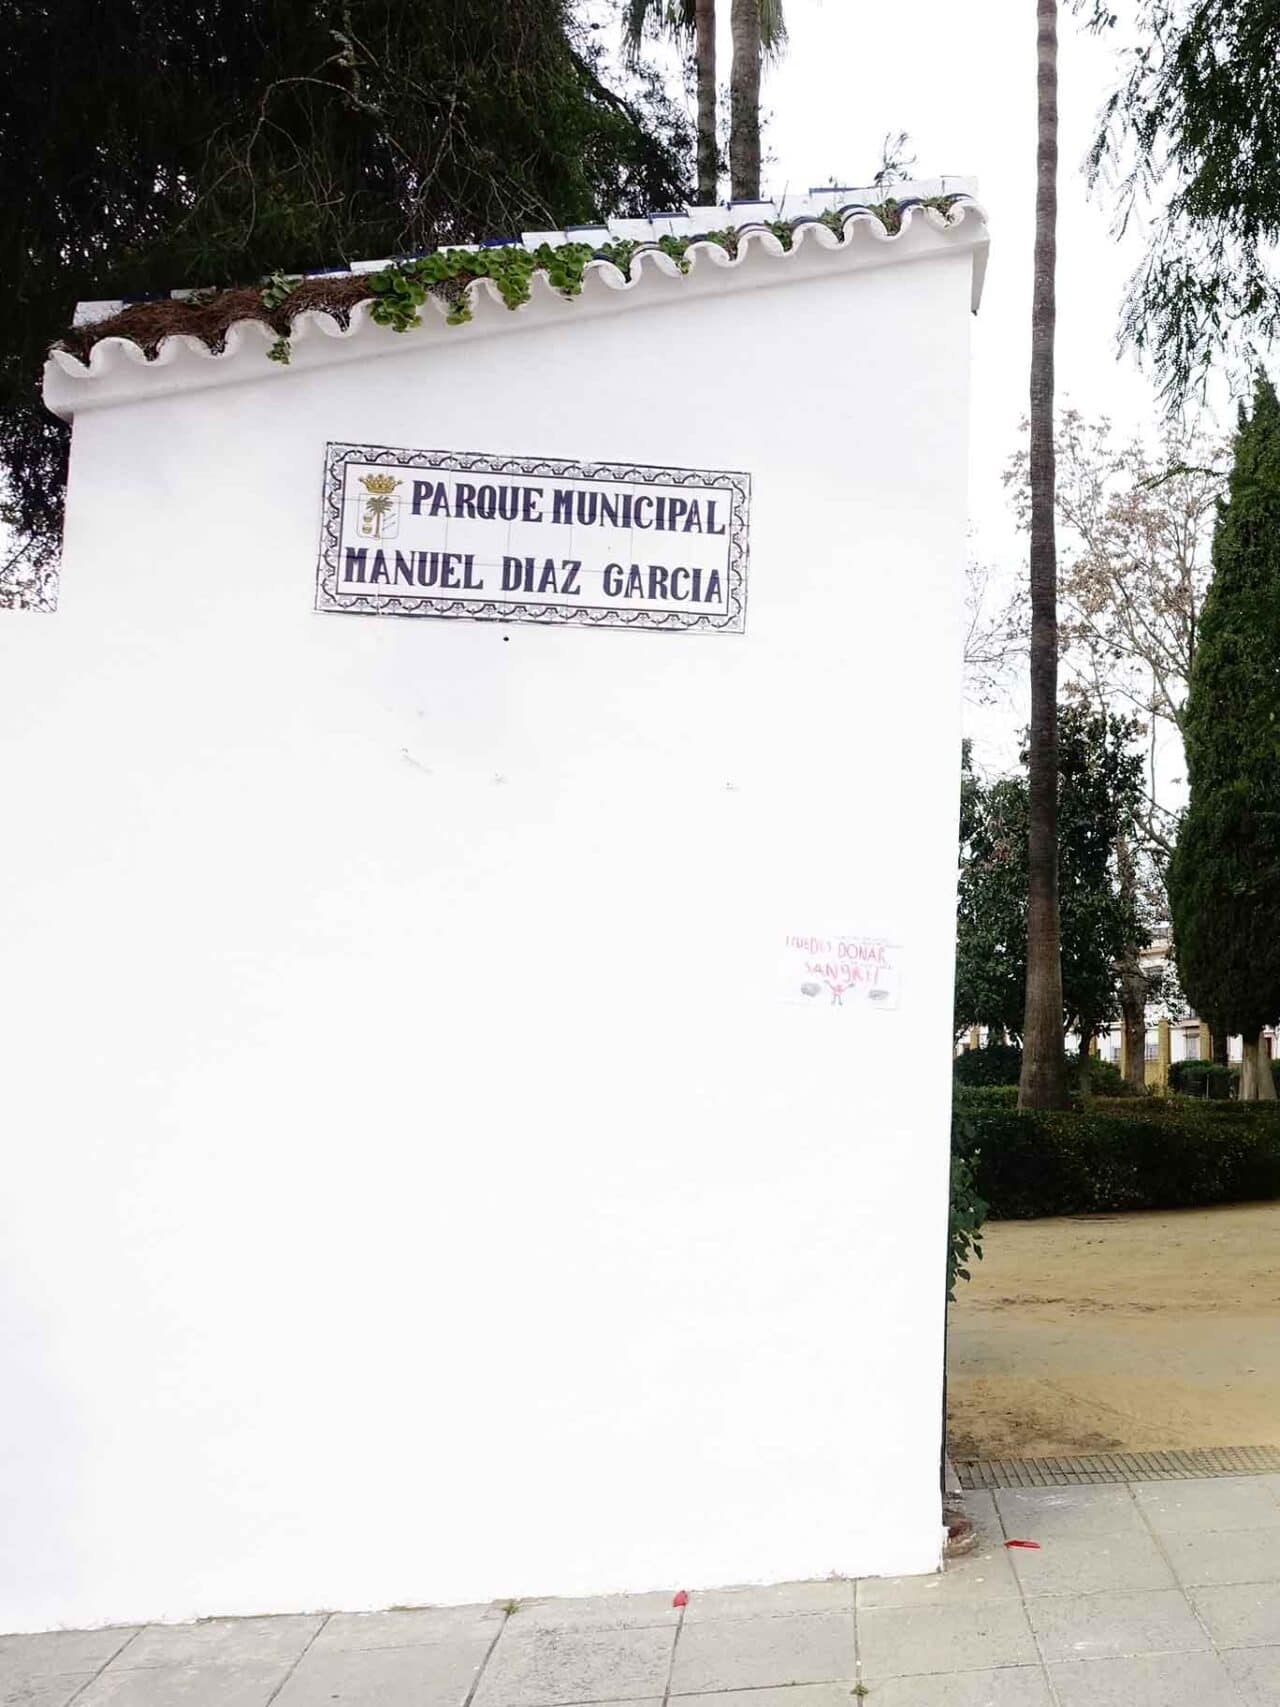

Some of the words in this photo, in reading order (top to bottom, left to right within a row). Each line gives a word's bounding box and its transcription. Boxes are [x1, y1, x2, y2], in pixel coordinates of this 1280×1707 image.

[411, 480, 544, 524] PARQUE
[552, 489, 727, 536] MUNICIPAL
[344, 546, 484, 591] MANUEL
[500, 556, 582, 596] DIAZ
[602, 563, 724, 605] GARCIA
[838, 941, 887, 964] DONAR
